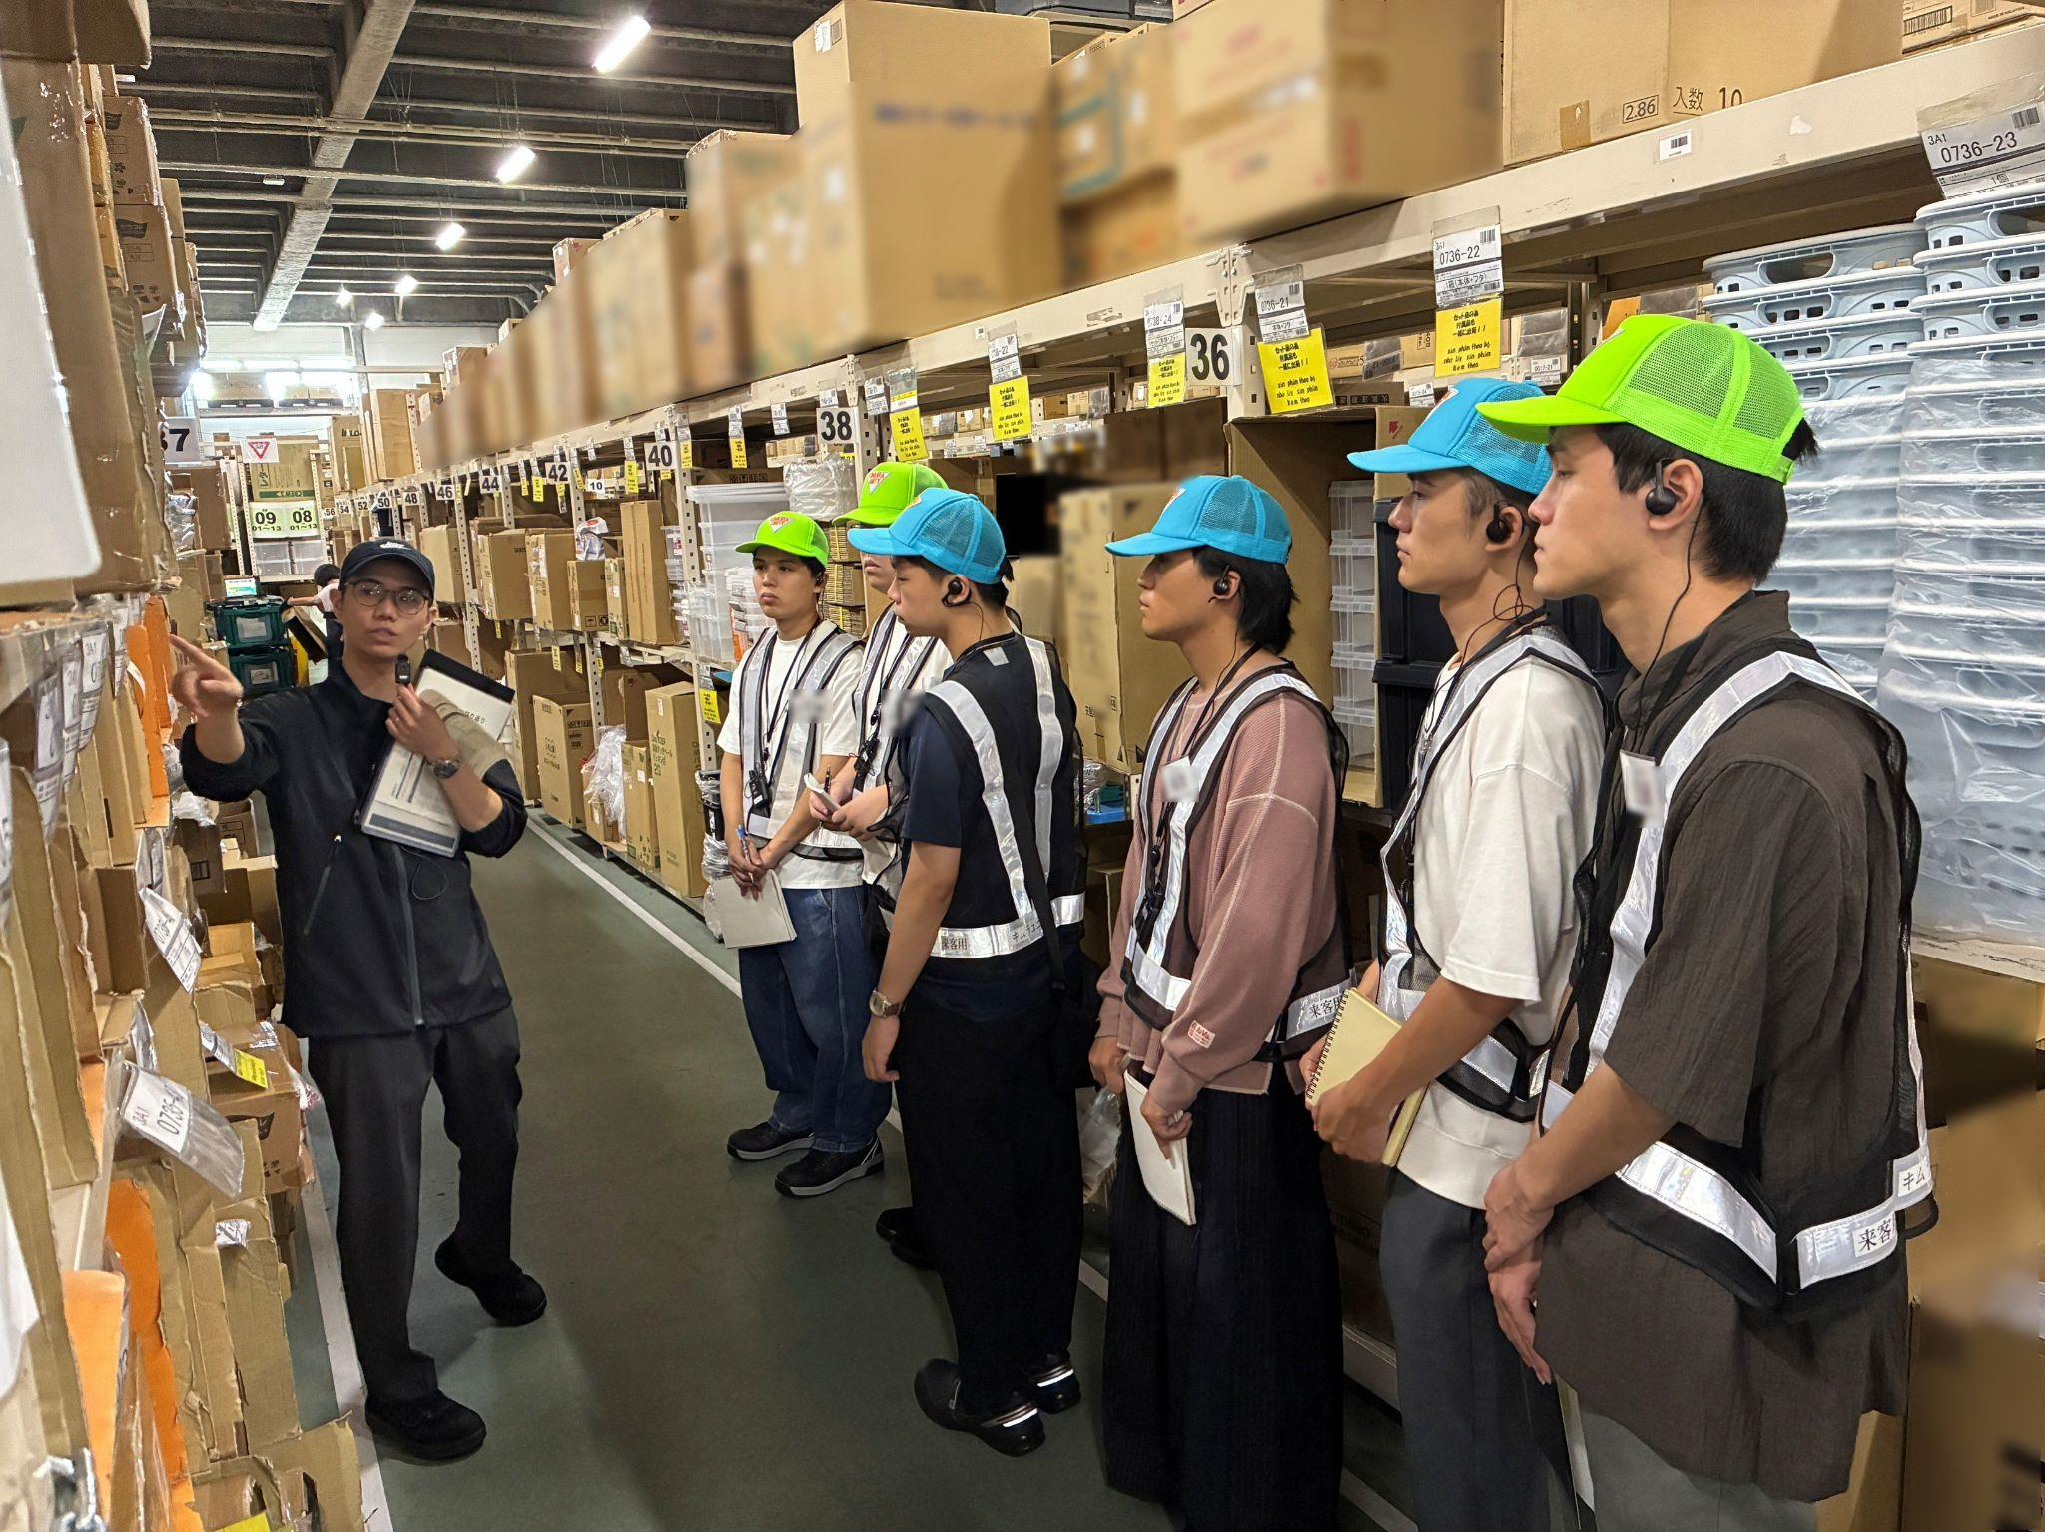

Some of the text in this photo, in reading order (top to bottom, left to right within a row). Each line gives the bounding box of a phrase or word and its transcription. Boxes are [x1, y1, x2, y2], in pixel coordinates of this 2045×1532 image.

[1673, 86, 1742, 111] 入数 10
[1625, 98, 1656, 121] 2.86
[1927, 133, 1947, 146] 3A1
[1940, 131, 2018, 163] 0736-23
[1439, 244, 1481, 265] 0736-22
[1190, 333, 1230, 381] 36
[820, 410, 853, 442] 38
[648, 444, 673, 467] 40
[548, 464, 568, 482] 42
[481, 477, 499, 491] 44
[590, 482, 603, 491] 10
[405, 493, 418, 504] 48
[437, 487, 453, 498] 46
[340, 506, 350, 514] 54
[357, 502, 368, 511] 52
[377, 498, 390, 508] 50
[255, 511, 277, 525] 09
[292, 510, 313, 524] 08
